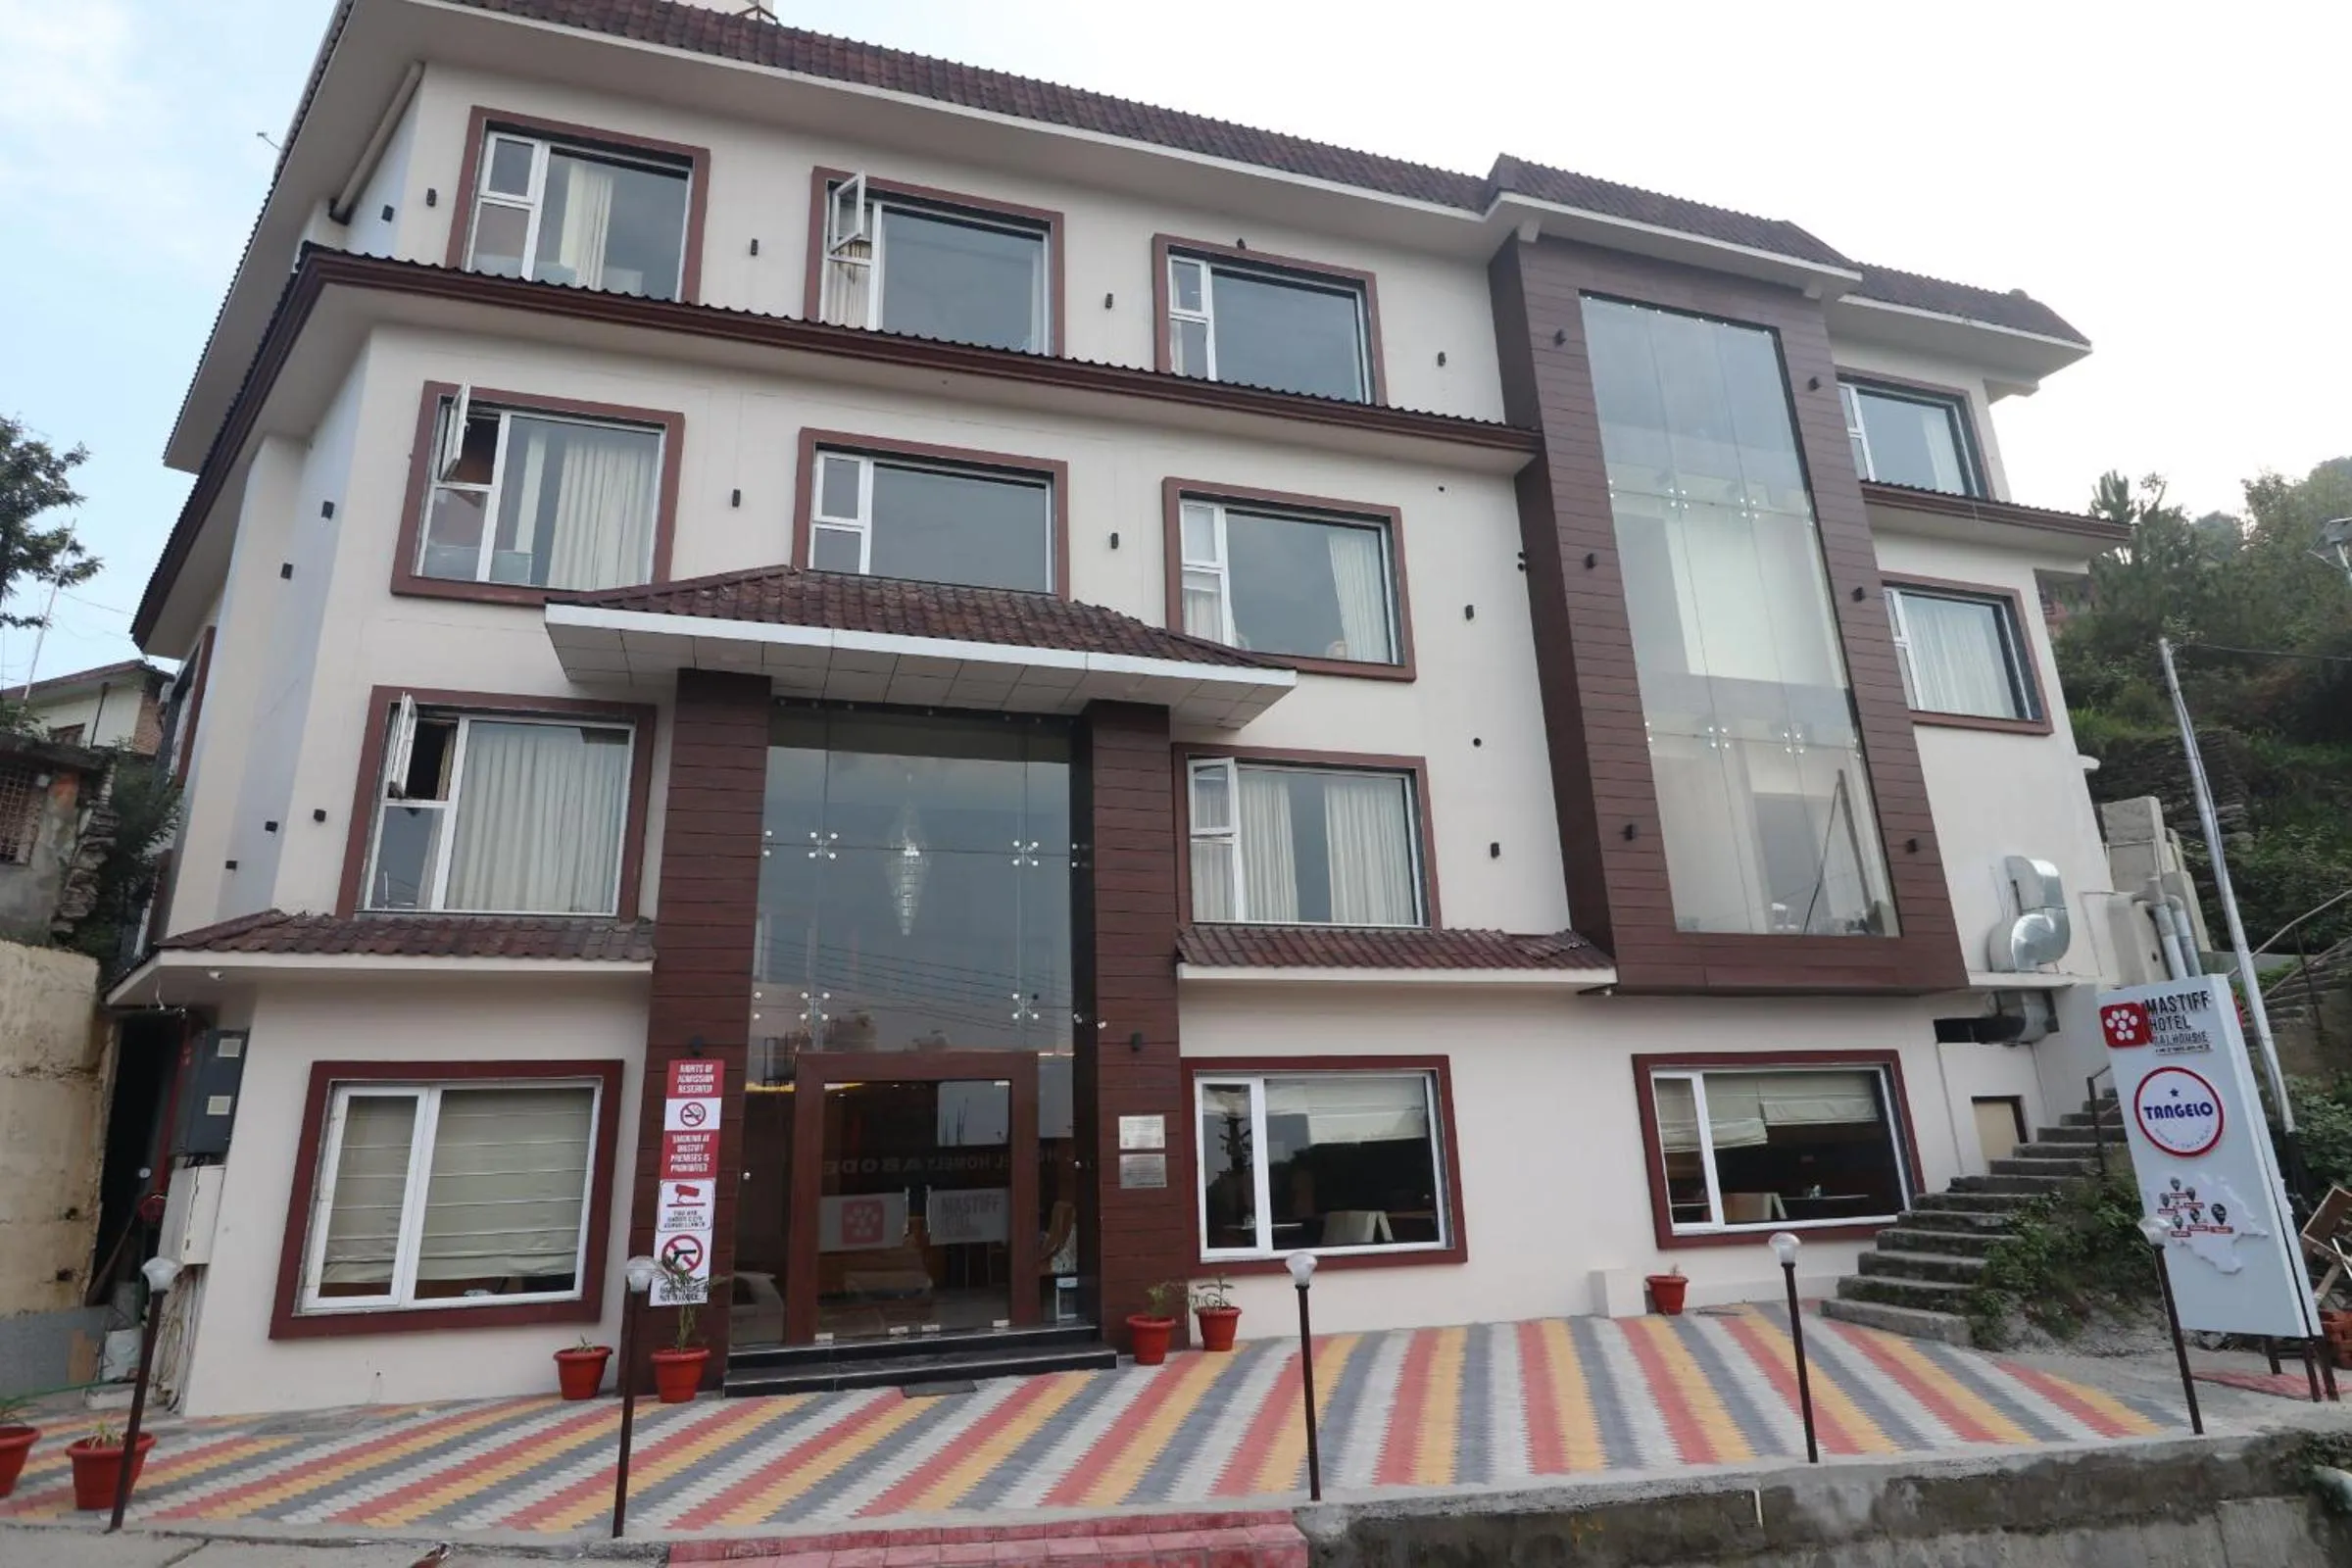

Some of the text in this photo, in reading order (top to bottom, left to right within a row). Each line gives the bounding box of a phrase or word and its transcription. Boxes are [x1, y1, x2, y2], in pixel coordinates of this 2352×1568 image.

[2144, 990, 2209, 1015] MASTIFF
[2149, 1014, 2191, 1031] HOTEL
[2143, 1101, 2214, 1120] TANGELO
[941, 1194, 1002, 1217] MASTIFF
